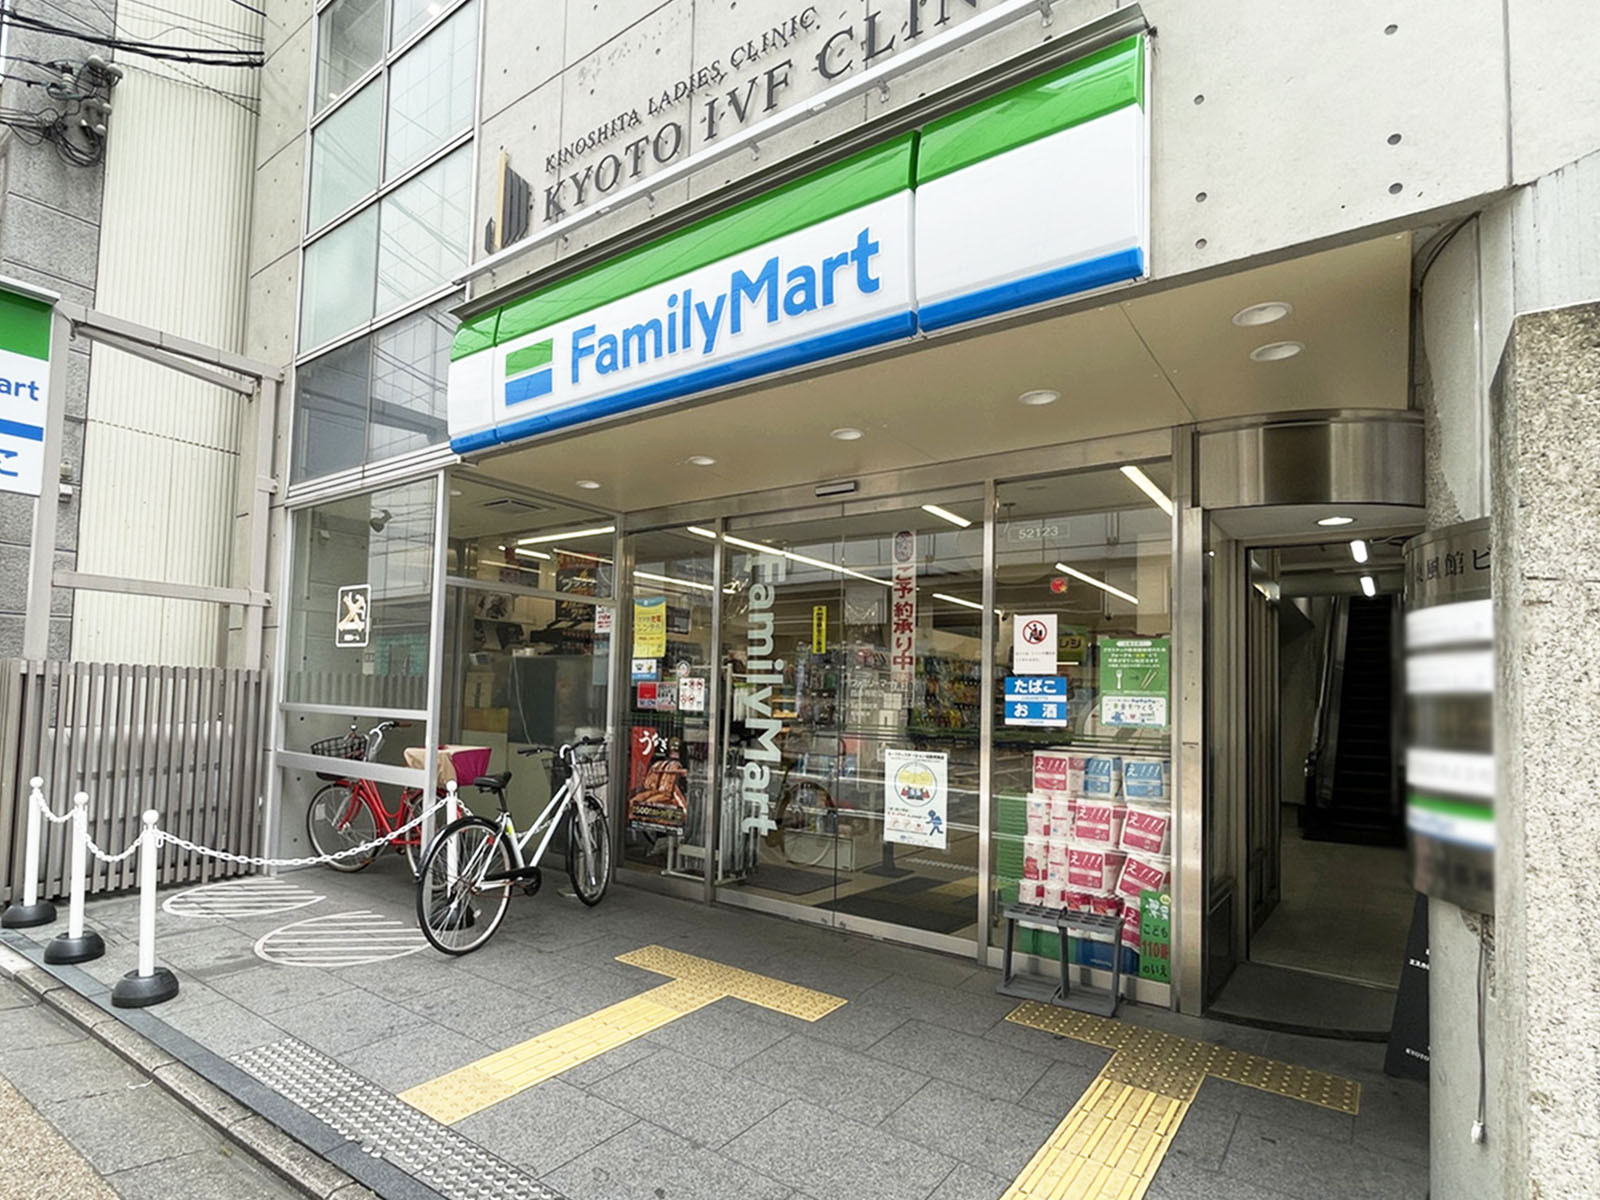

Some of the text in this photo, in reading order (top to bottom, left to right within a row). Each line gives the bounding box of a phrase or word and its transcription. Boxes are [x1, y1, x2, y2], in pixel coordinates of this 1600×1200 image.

[542, 122, 682, 222] KYOTO
[704, 59, 792, 142] IVF
[545, 7, 816, 173] KINOSHITA LADIES CLINIC
[571, 226, 881, 384] FamilyMart
[1019, 526, 1059, 540] 52123
[893, 564, 915, 671] ご予約承り中
[741, 553, 786, 837] FamilyMart
[1013, 678, 1057, 694] たばこ
[1143, 924, 1168, 940] こども
